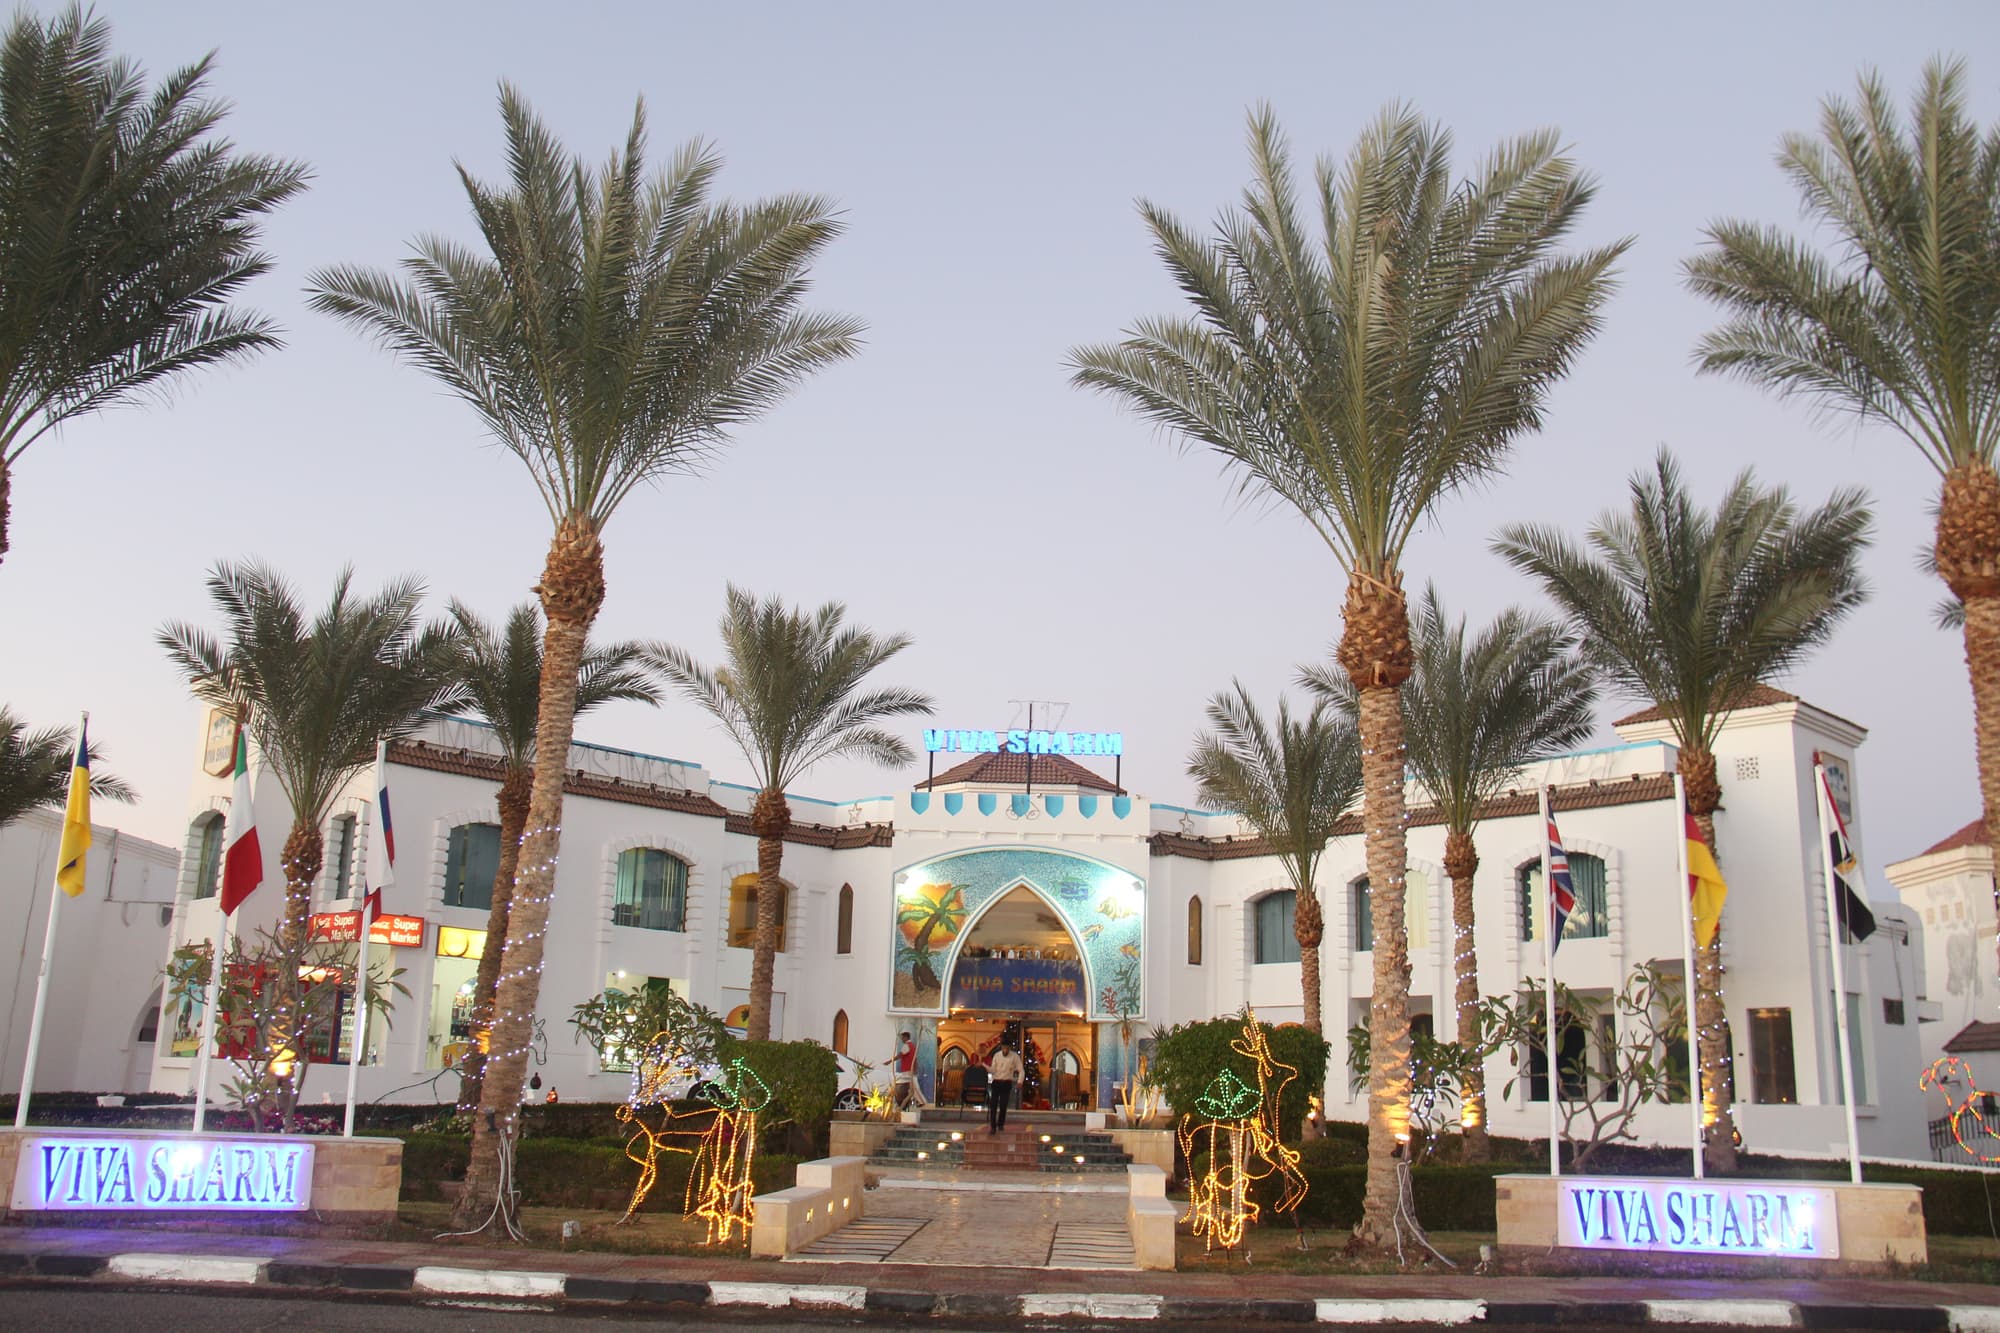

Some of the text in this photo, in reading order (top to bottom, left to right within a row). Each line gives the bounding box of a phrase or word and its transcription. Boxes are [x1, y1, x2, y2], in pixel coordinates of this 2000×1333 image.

[923, 729, 1122, 755] VIVA SHARM
[333, 915, 356, 927] Super
[393, 918, 420, 931] Super
[390, 931, 420, 945] Market
[960, 976, 1077, 994] VIVA SHARM
[41, 1145, 299, 1204] VIVA SHARM
[1571, 1188, 1815, 1250] VIVA SHARM
